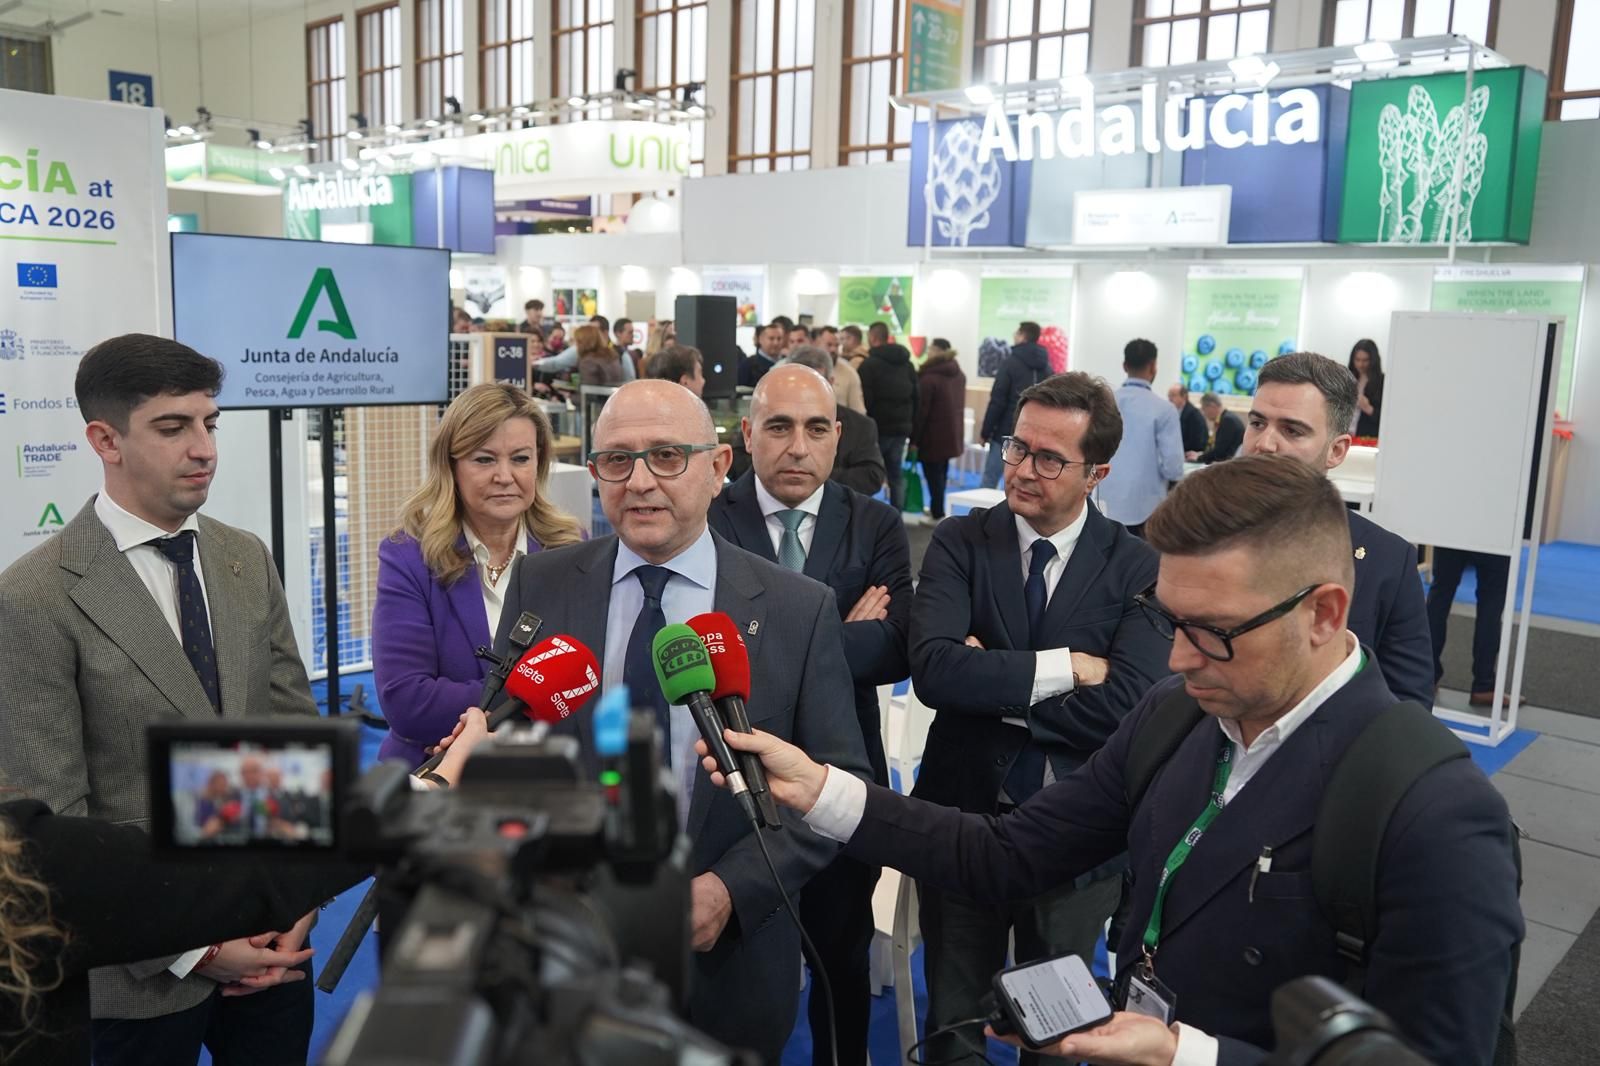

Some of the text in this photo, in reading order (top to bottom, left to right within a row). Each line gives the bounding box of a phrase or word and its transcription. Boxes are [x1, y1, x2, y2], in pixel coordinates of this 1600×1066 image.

[116, 82, 147, 105] 18
[977, 63, 1320, 163] Andalucía
[89, 180, 113, 199] at
[47, 206, 115, 230] 2026
[240, 346, 399, 363] Junta de Andalucía
[255, 372, 384, 384] Consejería de Agricultura,
[245, 384, 394, 398] Pesca, Agua y Desarrollo Rural
[14, 397, 62, 409] Fondos
[23, 442, 77, 453] Andalucía
[24, 453, 62, 463] TRADE
[517, 663, 545, 684] siete
